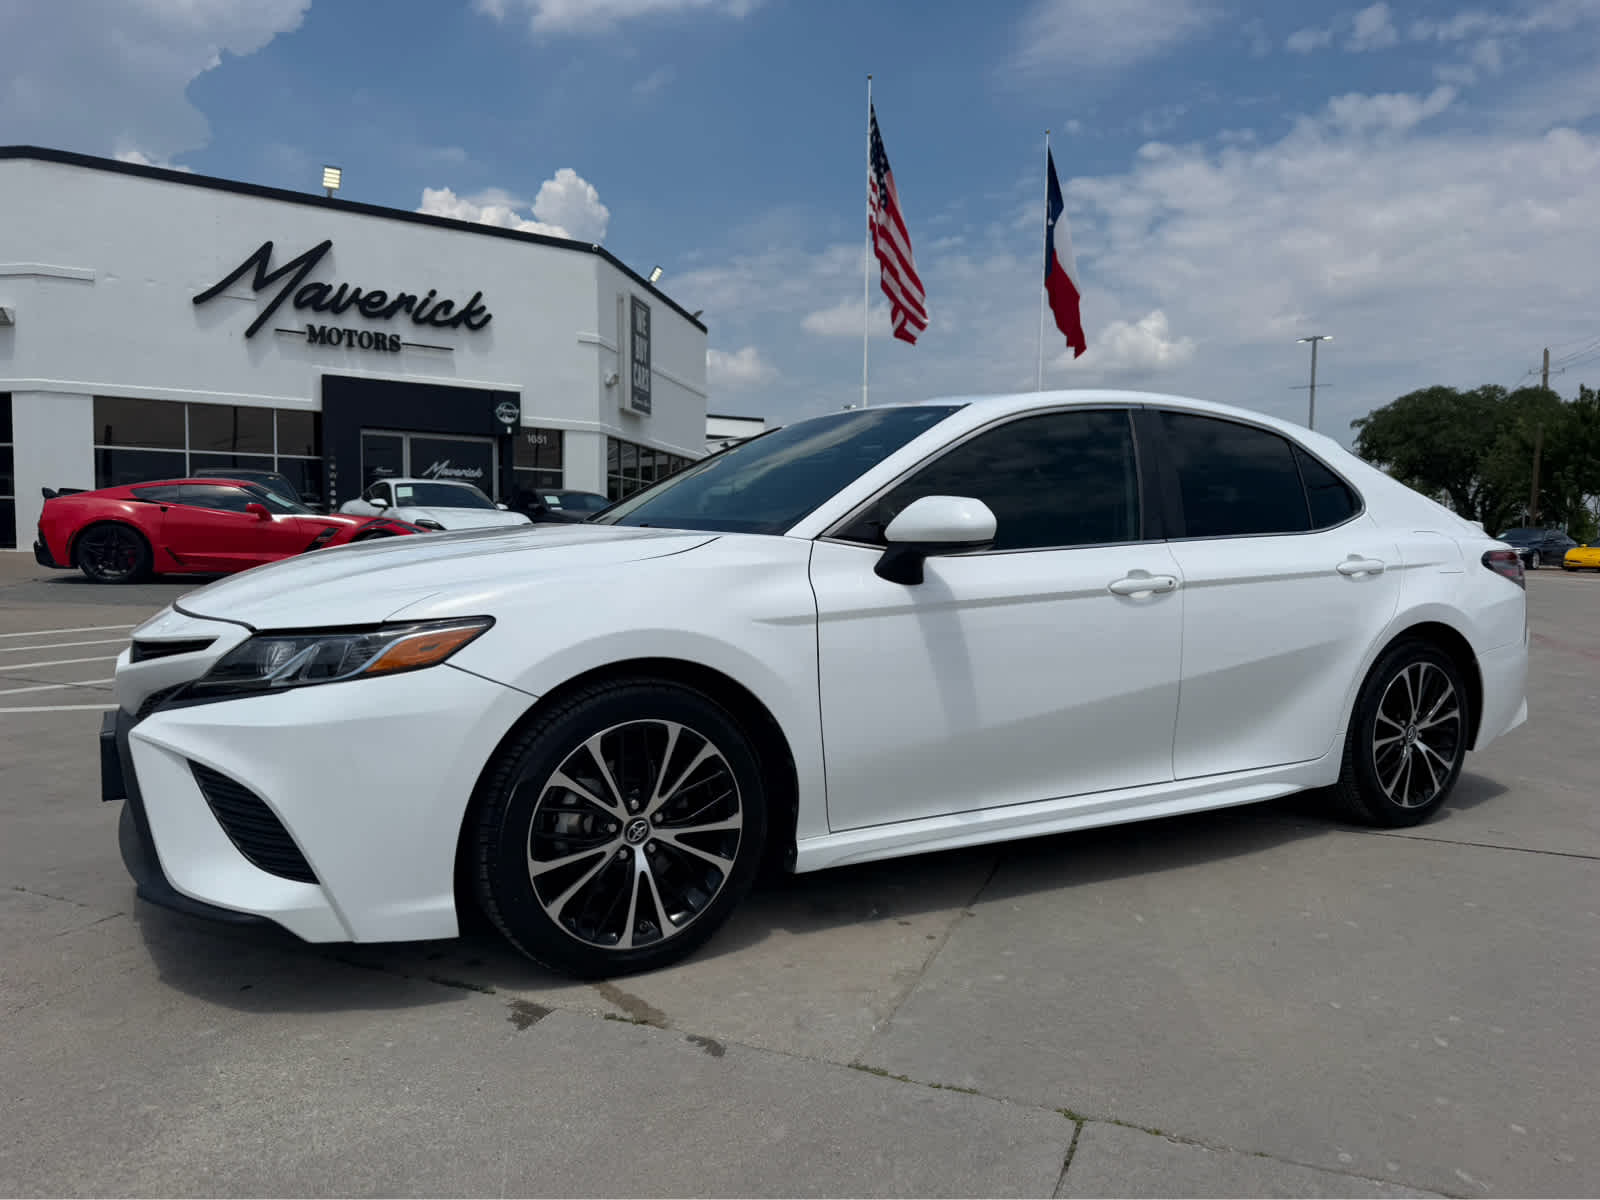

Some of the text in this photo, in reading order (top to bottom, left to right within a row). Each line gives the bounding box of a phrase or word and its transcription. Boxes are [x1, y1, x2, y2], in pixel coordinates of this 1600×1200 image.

[192, 239, 492, 338] Maverick
[307, 325, 401, 352] MOTORS
[422, 460, 483, 480] Maverick
